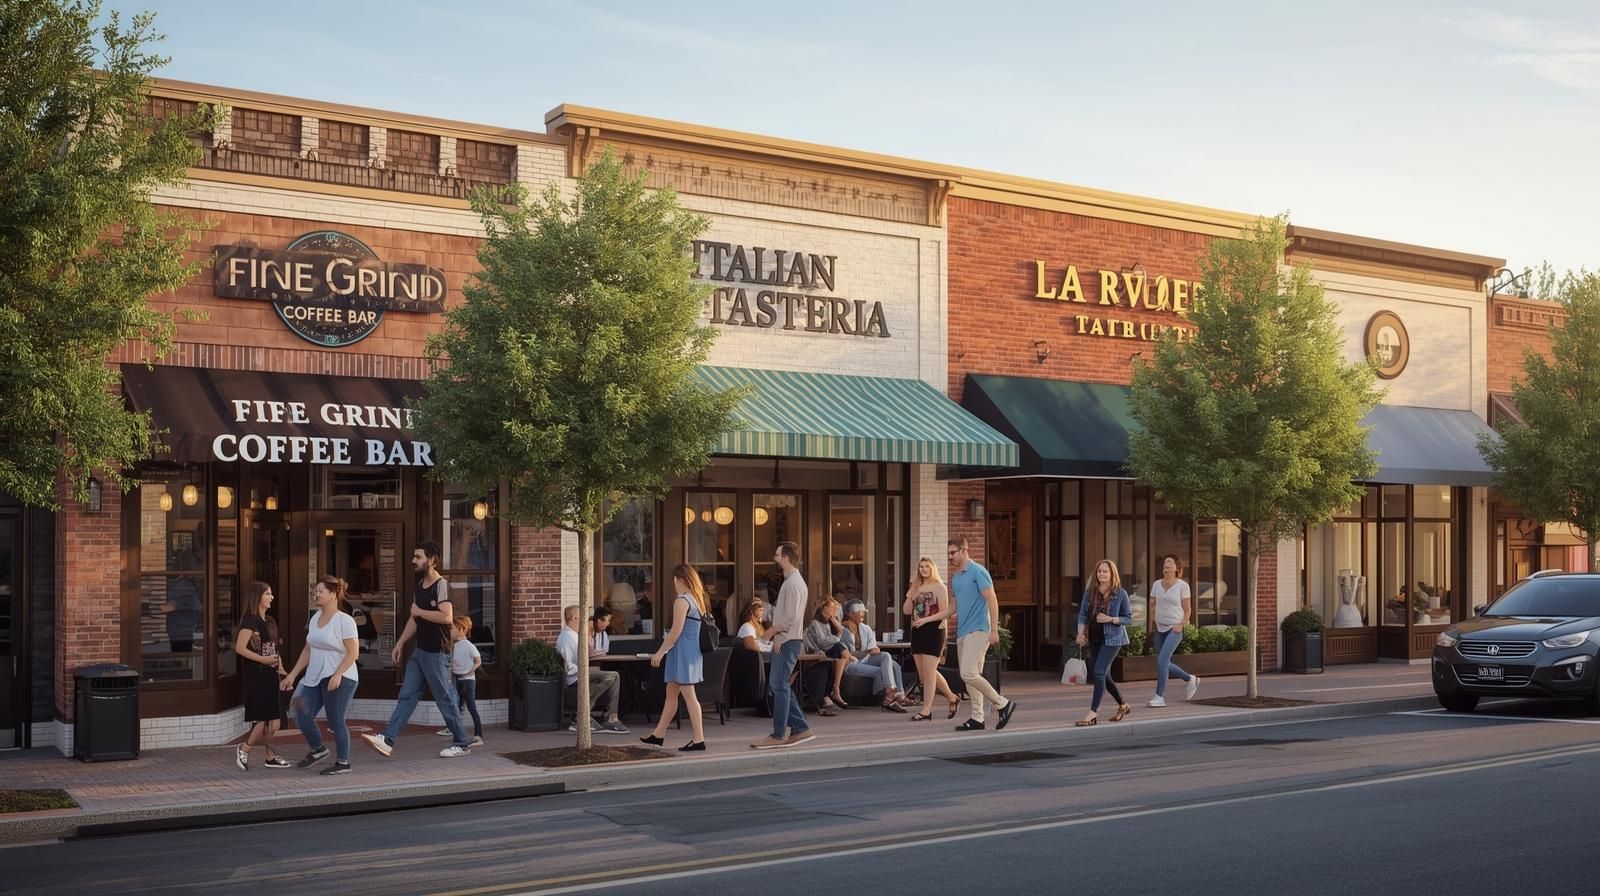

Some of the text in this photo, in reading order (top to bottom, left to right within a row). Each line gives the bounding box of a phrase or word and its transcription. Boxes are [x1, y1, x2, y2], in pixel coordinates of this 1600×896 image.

[228, 257, 443, 301] FINE GRIND
[690, 239, 838, 292] ITALIAN
[1034, 259, 1088, 303] LA
[283, 305, 377, 325] COFFEE BAR
[709, 286, 892, 338] TASTERIA
[231, 399, 310, 424] FIFE
[212, 433, 435, 467] COFFEE BAR
